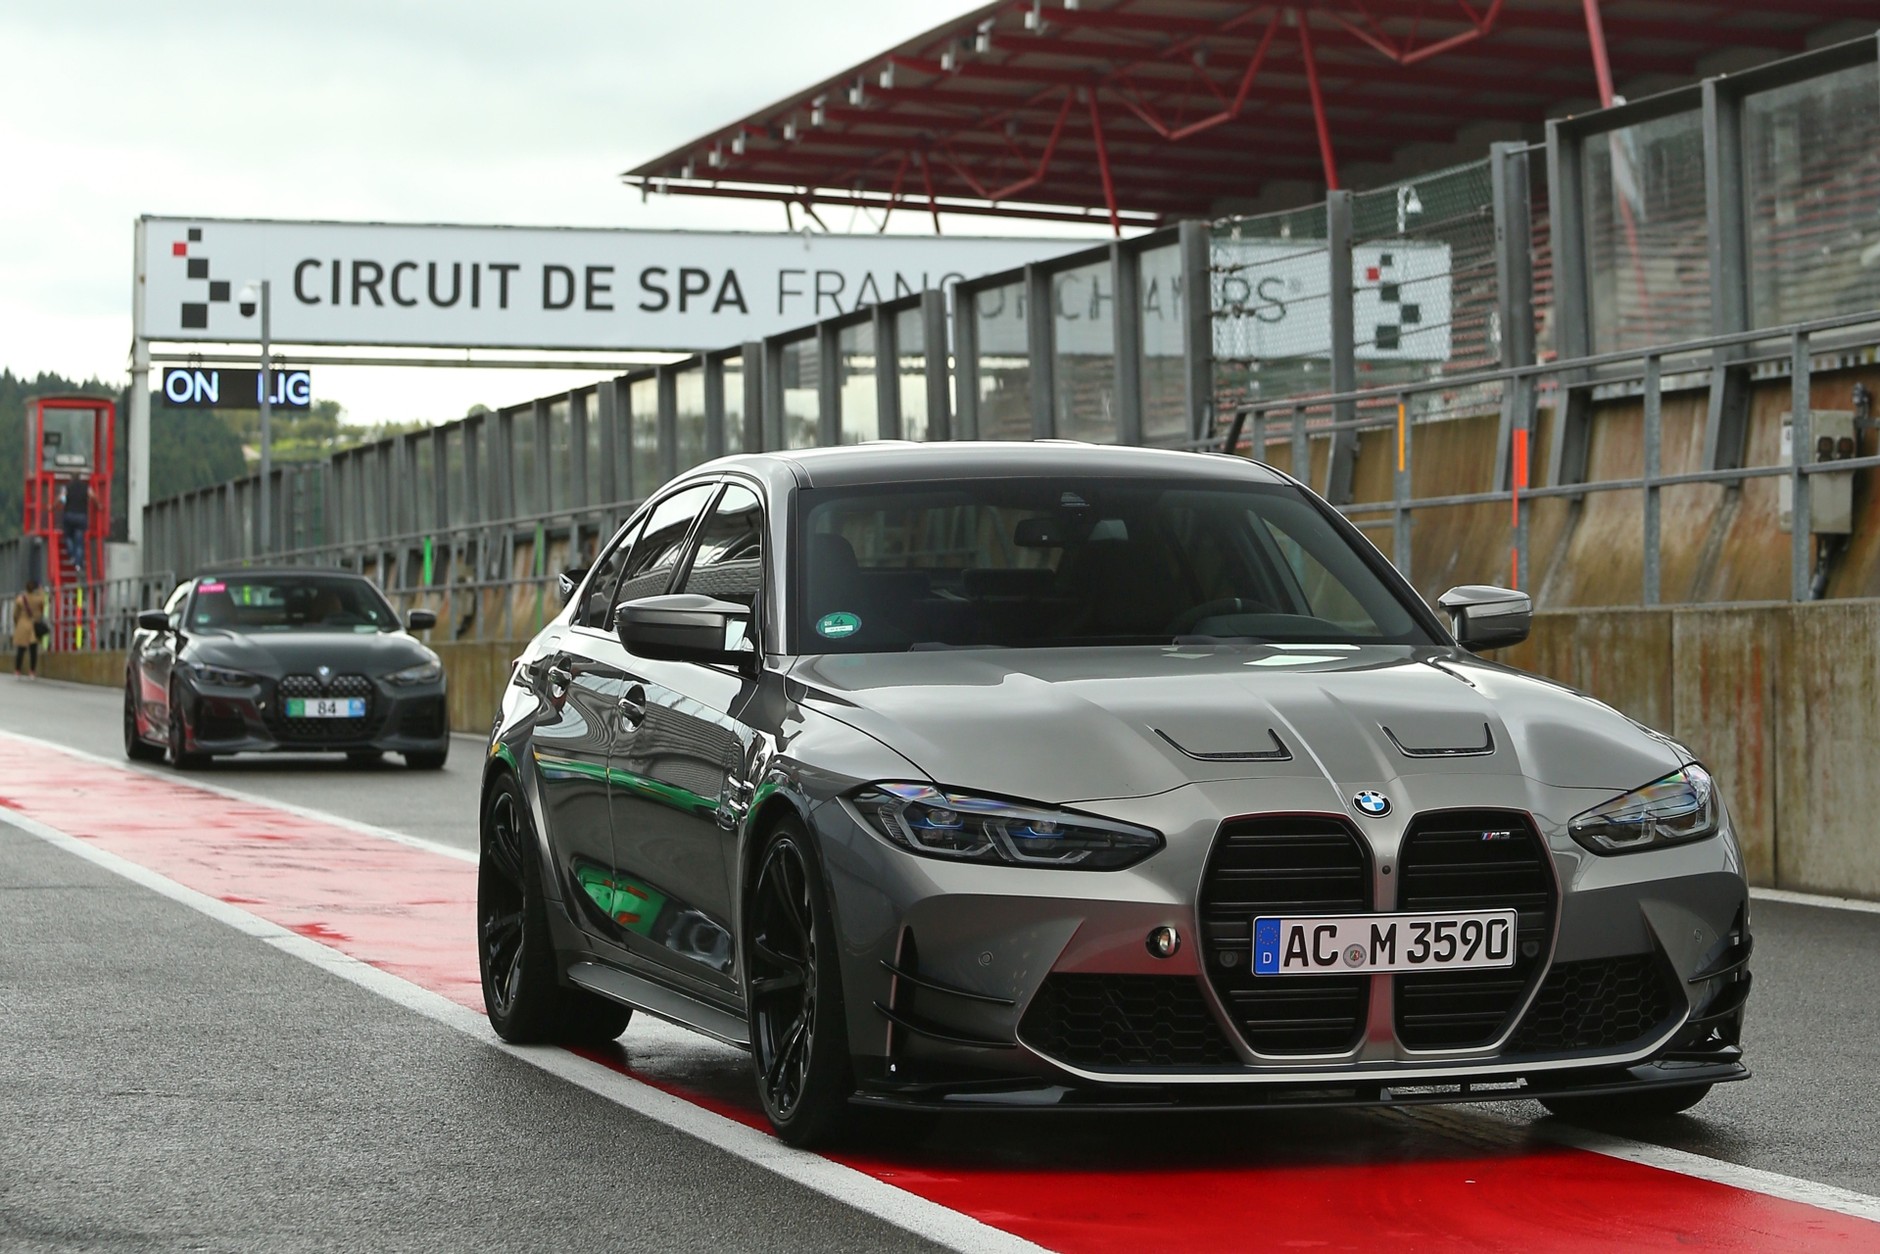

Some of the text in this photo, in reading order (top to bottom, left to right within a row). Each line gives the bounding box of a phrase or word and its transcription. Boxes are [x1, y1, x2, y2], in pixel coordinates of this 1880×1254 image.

[293, 257, 520, 309] CIRCUIT
[542, 264, 615, 311] DE
[637, 266, 750, 314] SPA
[165, 369, 219, 403] ON
[318, 700, 336, 715] 84
[1262, 918, 1509, 967] D AC M 3590
